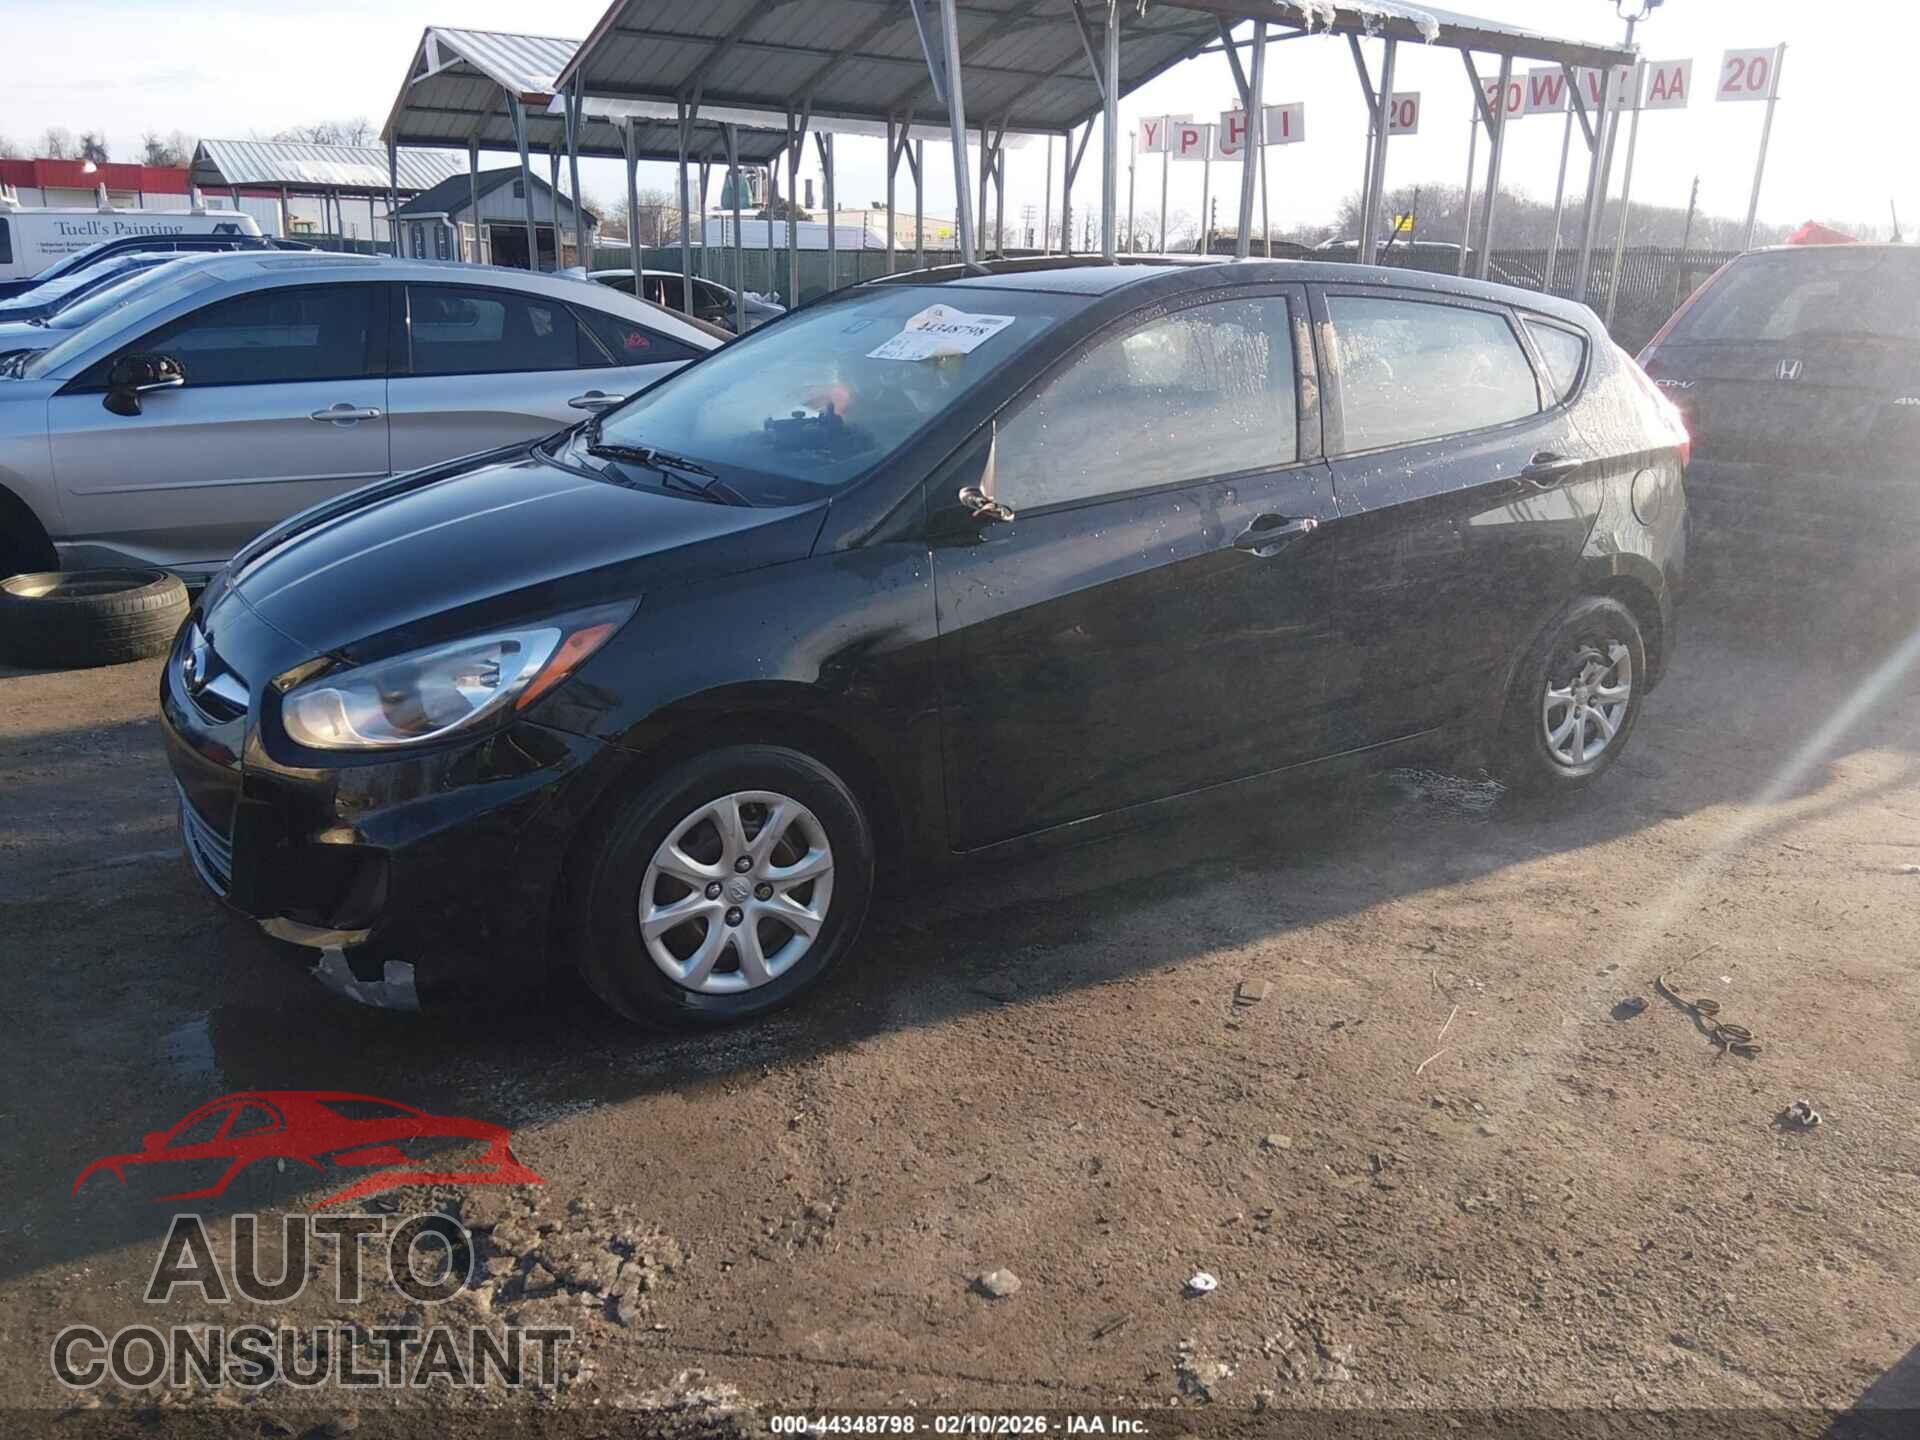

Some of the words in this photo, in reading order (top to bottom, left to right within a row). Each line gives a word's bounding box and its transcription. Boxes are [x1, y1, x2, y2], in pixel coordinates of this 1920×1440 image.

[1650, 67, 1684, 101] AA
[1721, 56, 1768, 92] 20
[1486, 83, 1522, 112] 20
[1531, 75, 1566, 106] W
[1144, 122, 1158, 147] Y
[1181, 130, 1198, 154] P
[54, 221, 110, 236] Tuell's
[113, 221, 184, 235] Painting
[917, 317, 988, 336] 44348798
